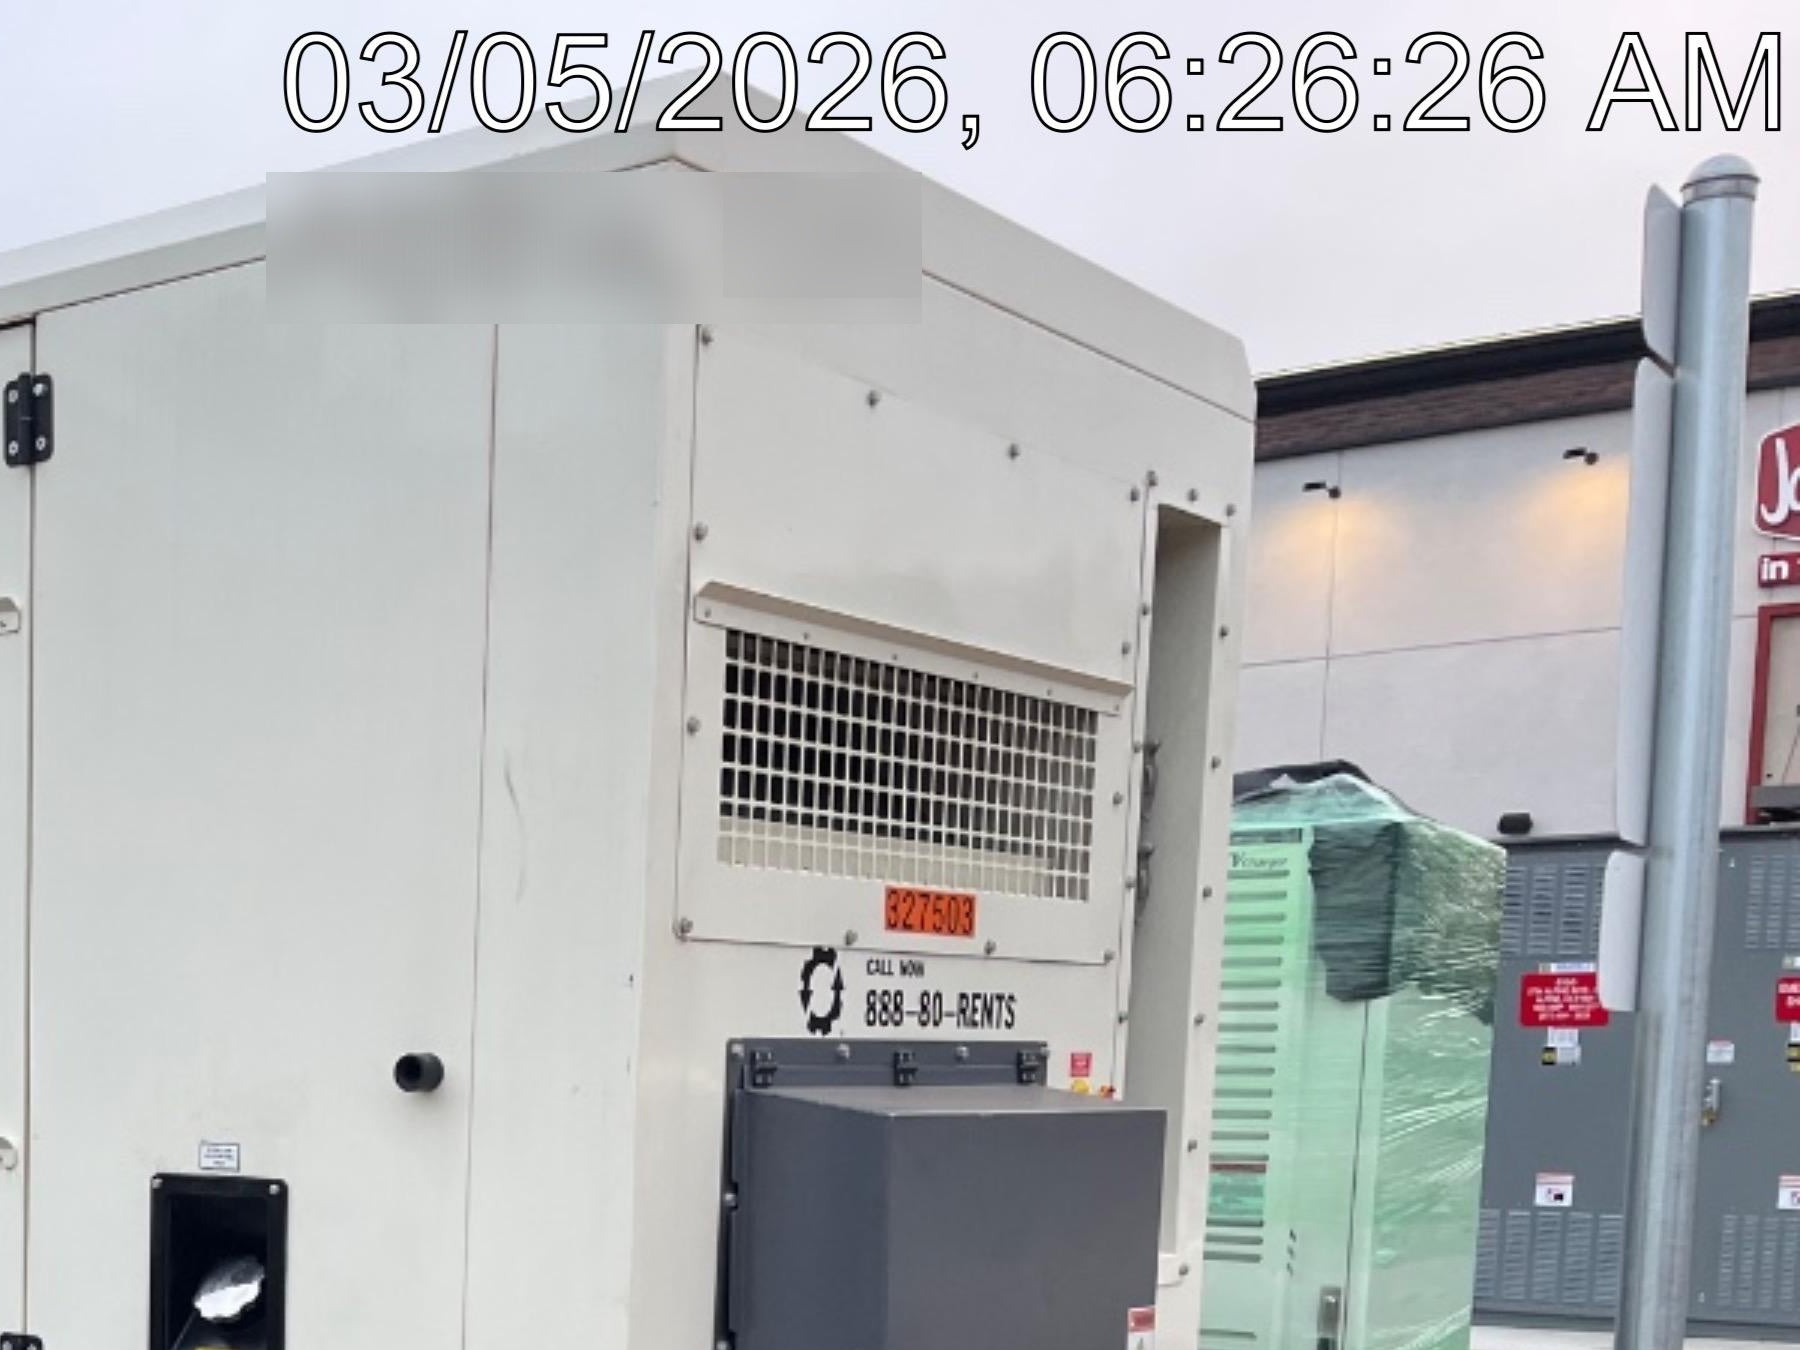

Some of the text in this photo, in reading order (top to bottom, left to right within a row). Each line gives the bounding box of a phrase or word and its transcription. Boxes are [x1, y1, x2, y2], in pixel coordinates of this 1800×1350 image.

[1760, 557, 1790, 582] in
[886, 889, 975, 936] 327503
[866, 958, 925, 977] CALL NOW
[865, 988, 1017, 1031] 888-80-RENTS
